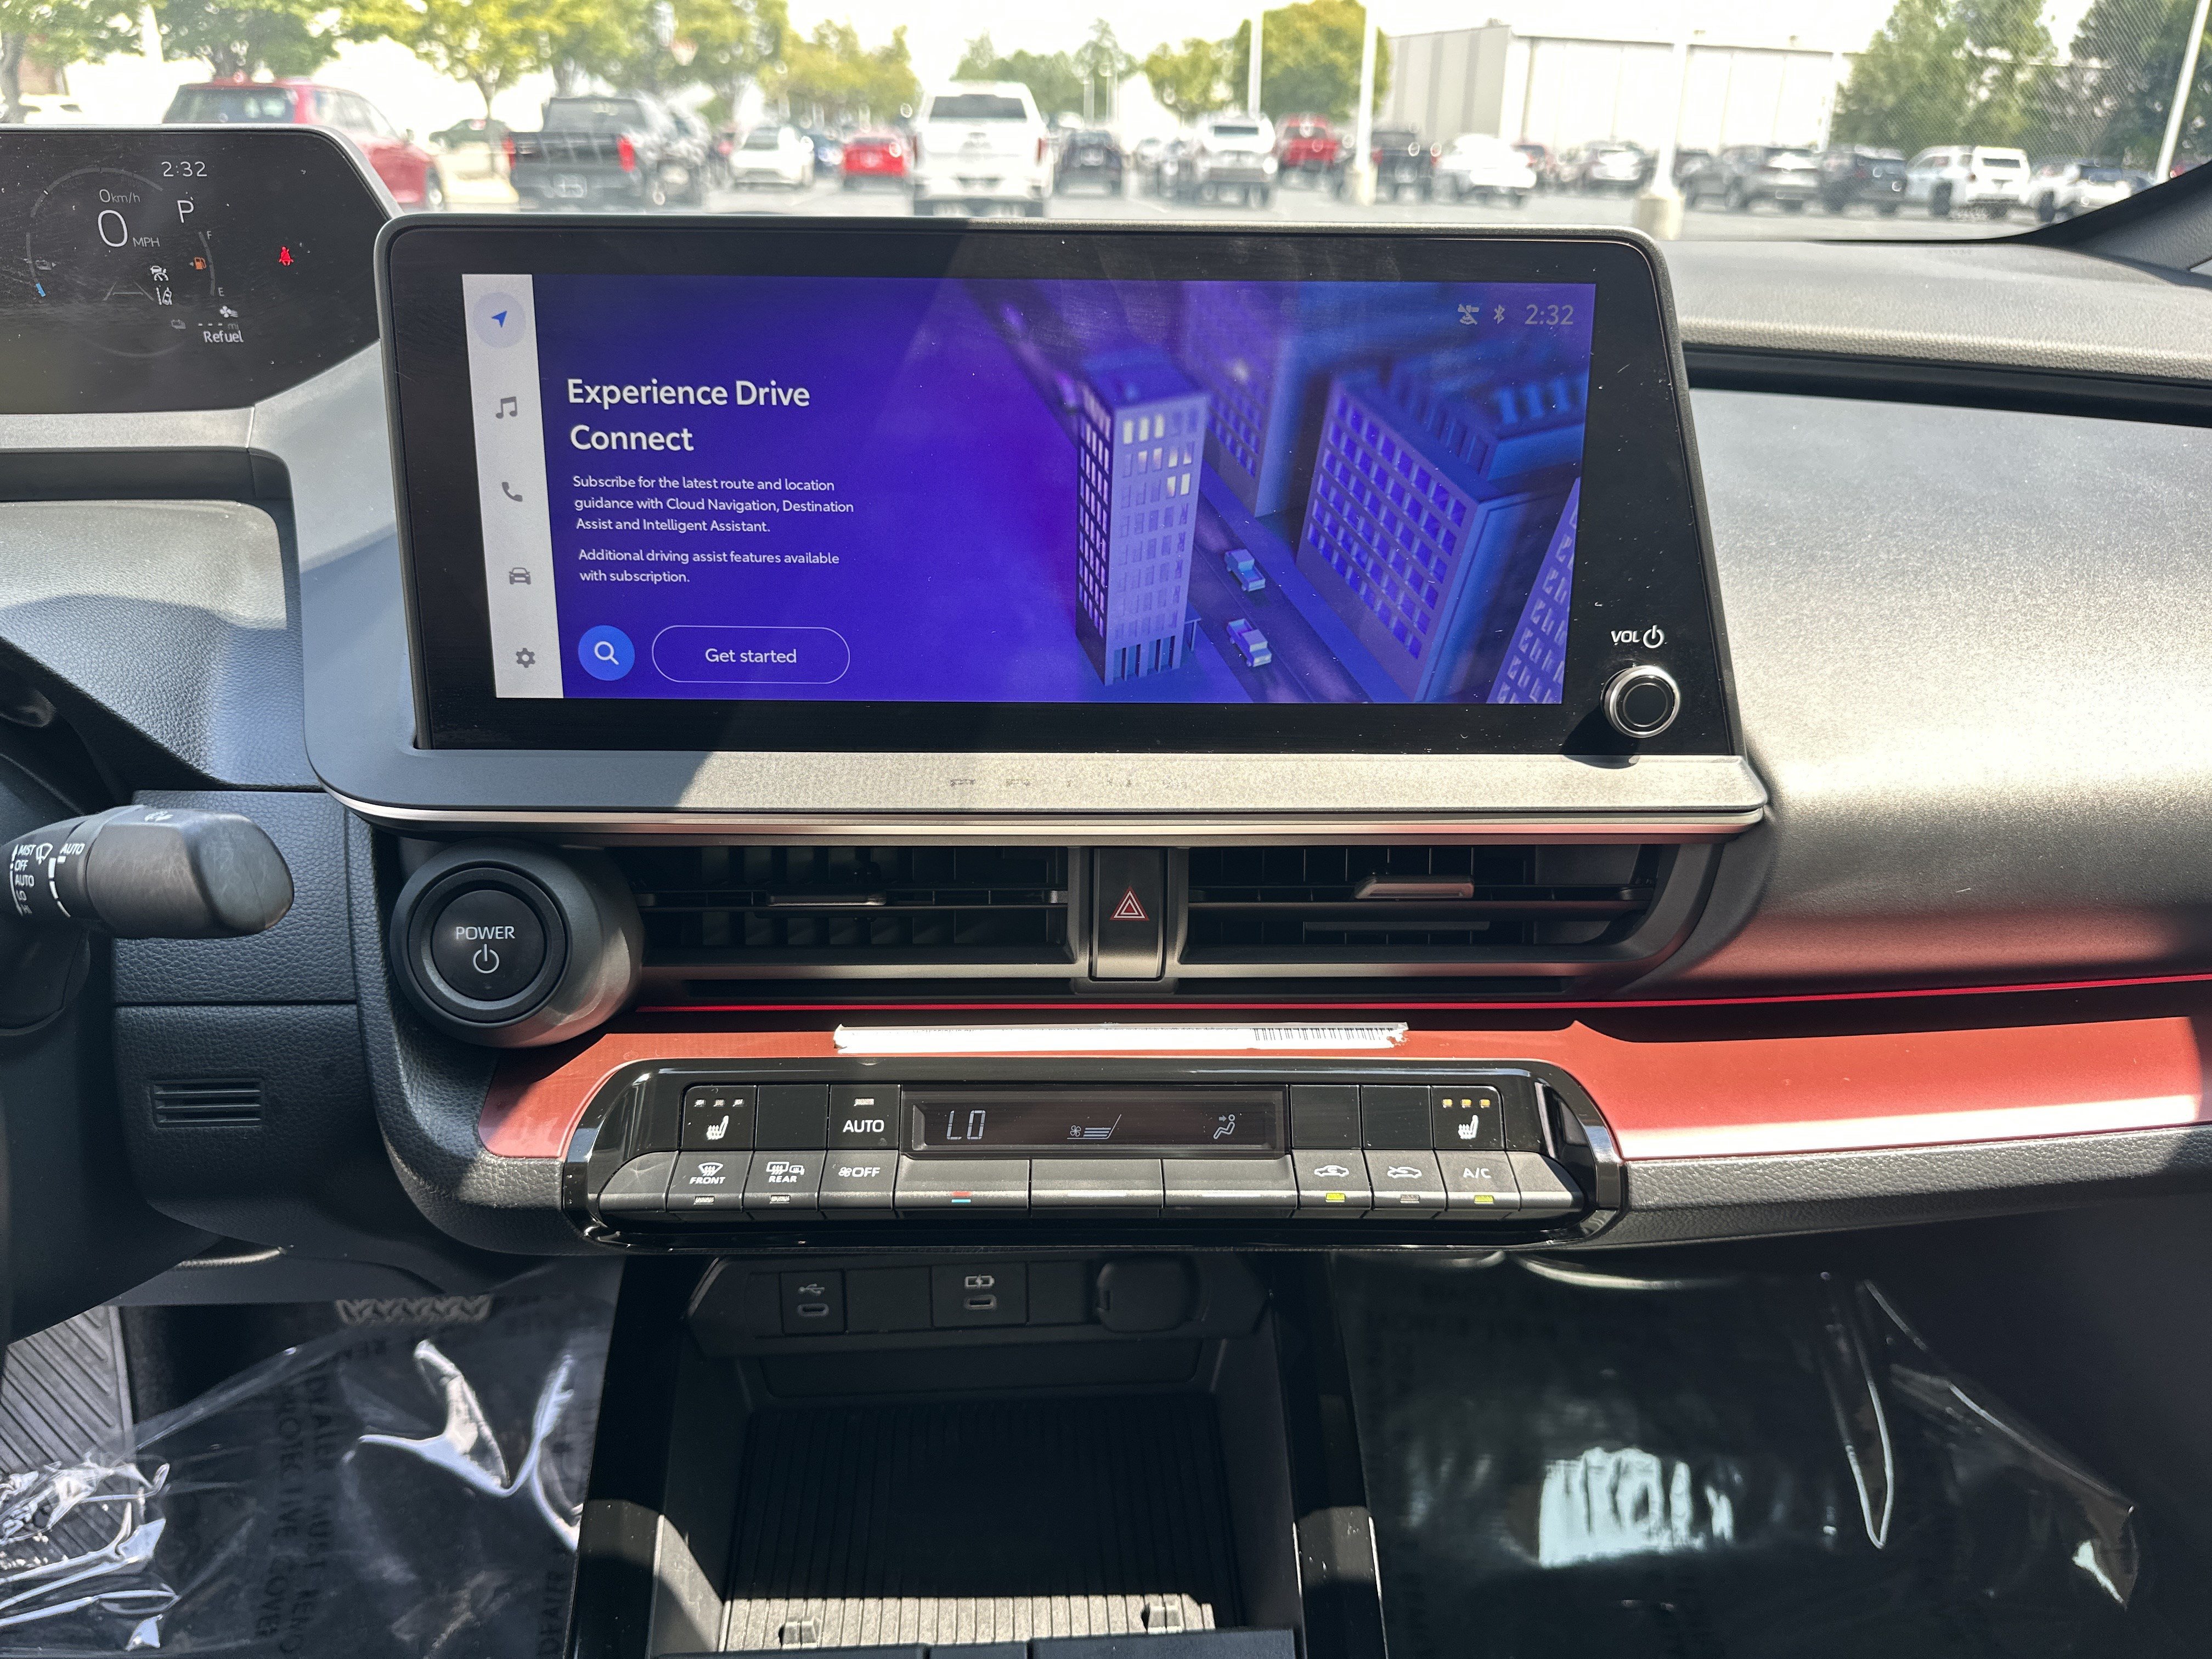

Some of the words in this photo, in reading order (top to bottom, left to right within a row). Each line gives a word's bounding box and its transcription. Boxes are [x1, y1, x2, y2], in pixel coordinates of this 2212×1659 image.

[161, 161, 207, 177] 2:32
[177, 200, 194, 223] P
[98, 210, 128, 247] 0
[132, 237, 160, 247] MPH
[206, 230, 212, 240] F
[218, 287, 225, 297] E
[1525, 304, 1573, 325] 2:32
[203, 330, 244, 343] Refuel
[567, 378, 728, 410] Experience
[736, 380, 810, 407] Drive
[570, 424, 694, 451] Connect
[573, 475, 636, 488] Subscribe
[638, 475, 656, 488] for
[658, 476, 679, 489] the
[682, 476, 718, 489] latest
[720, 478, 754, 490] route
[757, 478, 782, 491] and
[785, 478, 835, 492] location
[574, 498, 634, 511] guidance
[636, 498, 663, 510] with
[666, 498, 705, 511] Cloud
[708, 498, 780, 514] Navigation,
[782, 500, 854, 514] Destination
[576, 518, 613, 530] Assist
[616, 518, 640, 531] and
[642, 518, 707, 533] Intelligent
[710, 520, 770, 532] Assistant.
[579, 549, 644, 562] Additional
[646, 550, 689, 565] driving
[692, 551, 728, 563] assist
[730, 551, 781, 564] features
[784, 551, 839, 565] available
[579, 569, 607, 582] with
[610, 570, 690, 585] subscription.
[1611, 630, 1640, 643] VOL
[705, 648, 736, 663] Get
[741, 648, 797, 664] started
[18, 844, 36, 856] MIST
[60, 843, 85, 855] AUTO
[14, 860, 29, 872] OFF
[15, 874, 35, 888] AUTO
[455, 926, 515, 940] POWER
[842, 1119, 884, 1132] AUTO
[851, 1166, 881, 1178] OFF
[1463, 1167, 1492, 1179] A/C
[689, 1176, 725, 1184] FRONT
